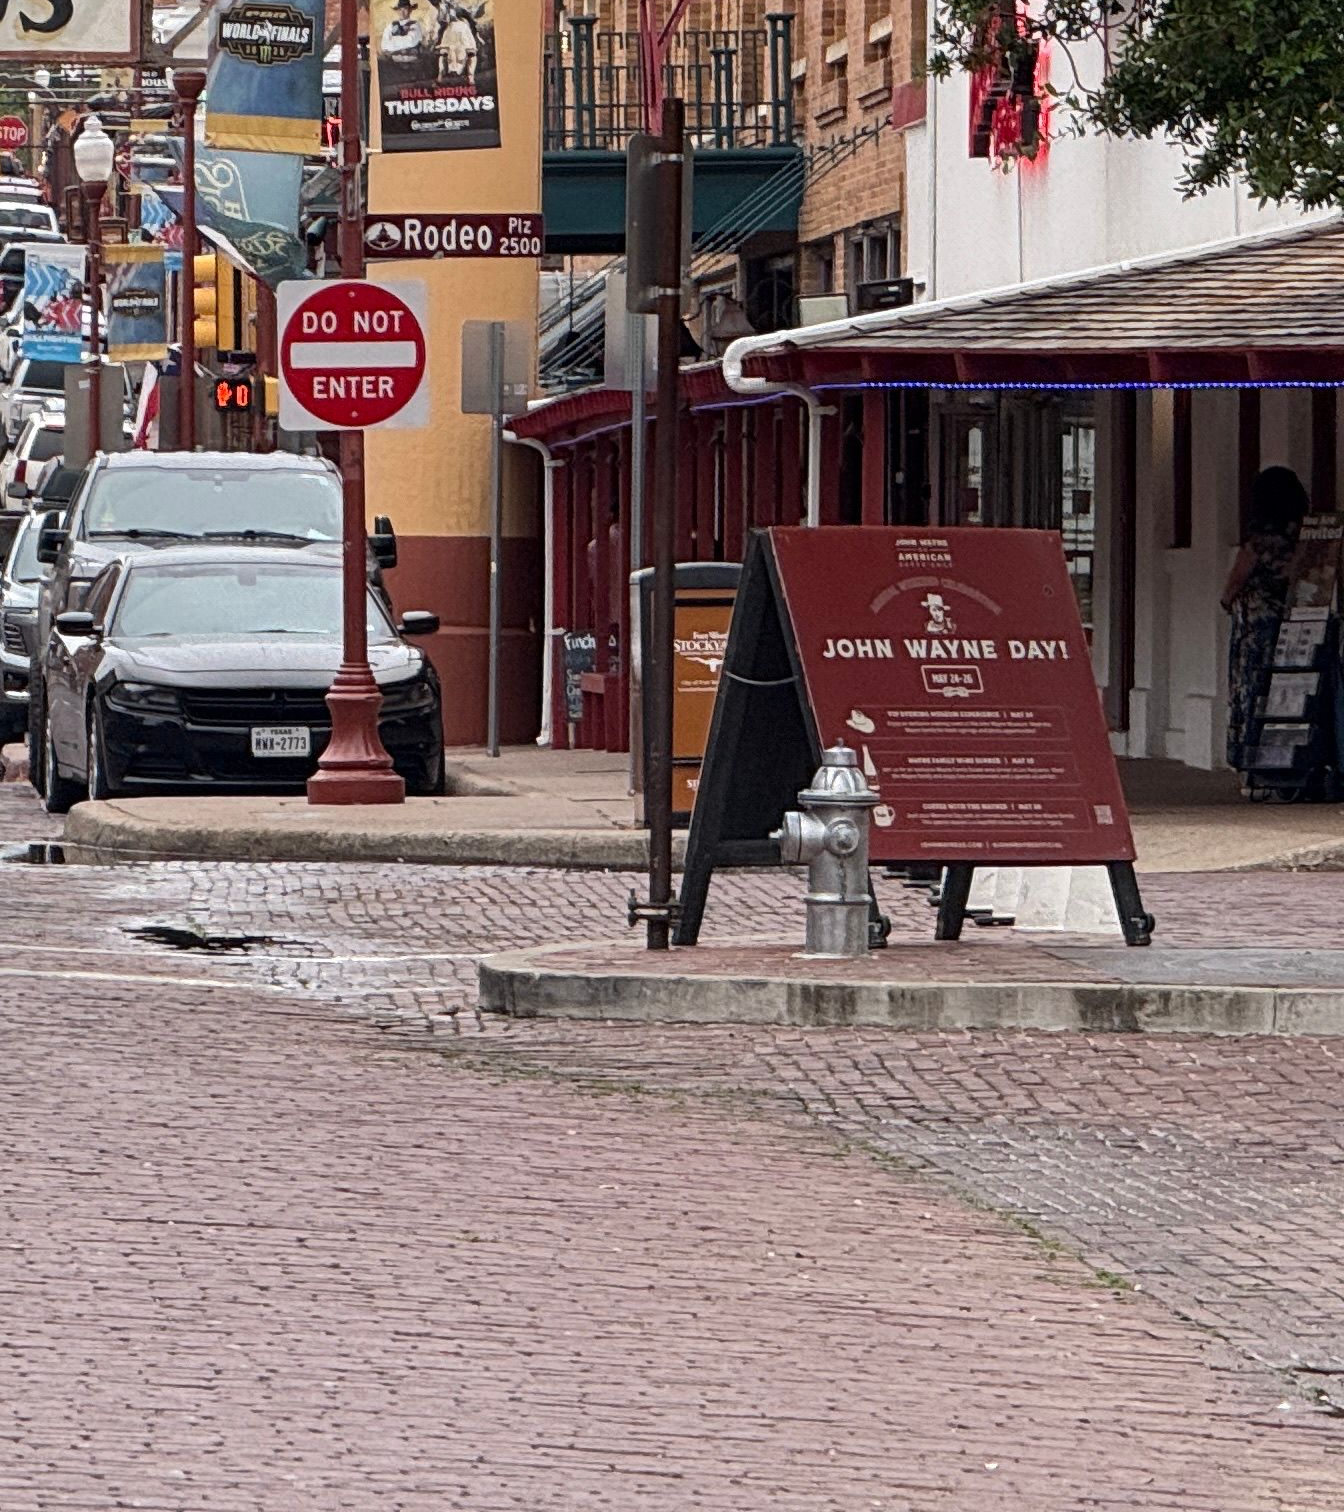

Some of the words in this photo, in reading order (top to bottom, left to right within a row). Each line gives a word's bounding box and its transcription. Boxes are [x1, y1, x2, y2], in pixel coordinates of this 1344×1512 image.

[223, 22, 261, 40] WORLD
[271, 25, 310, 43] FINALS
[400, 88, 431, 99] BULL
[384, 96, 495, 116] THURSDAYS
[404, 218, 493, 251] Rodeo
[508, 217, 532, 235] Plz
[499, 237, 541, 255] 2500
[302, 310, 338, 334] DO
[353, 309, 404, 334] NOT
[312, 376, 394, 399] ENTER
[898, 552, 952, 561] AMERICAN
[673, 638, 727, 653] STOCKYA
[822, 638, 895, 659] JOHN
[904, 639, 999, 660] WAYNE
[1007, 640, 1069, 660] DAY!
[932, 673, 948, 683] MAY
